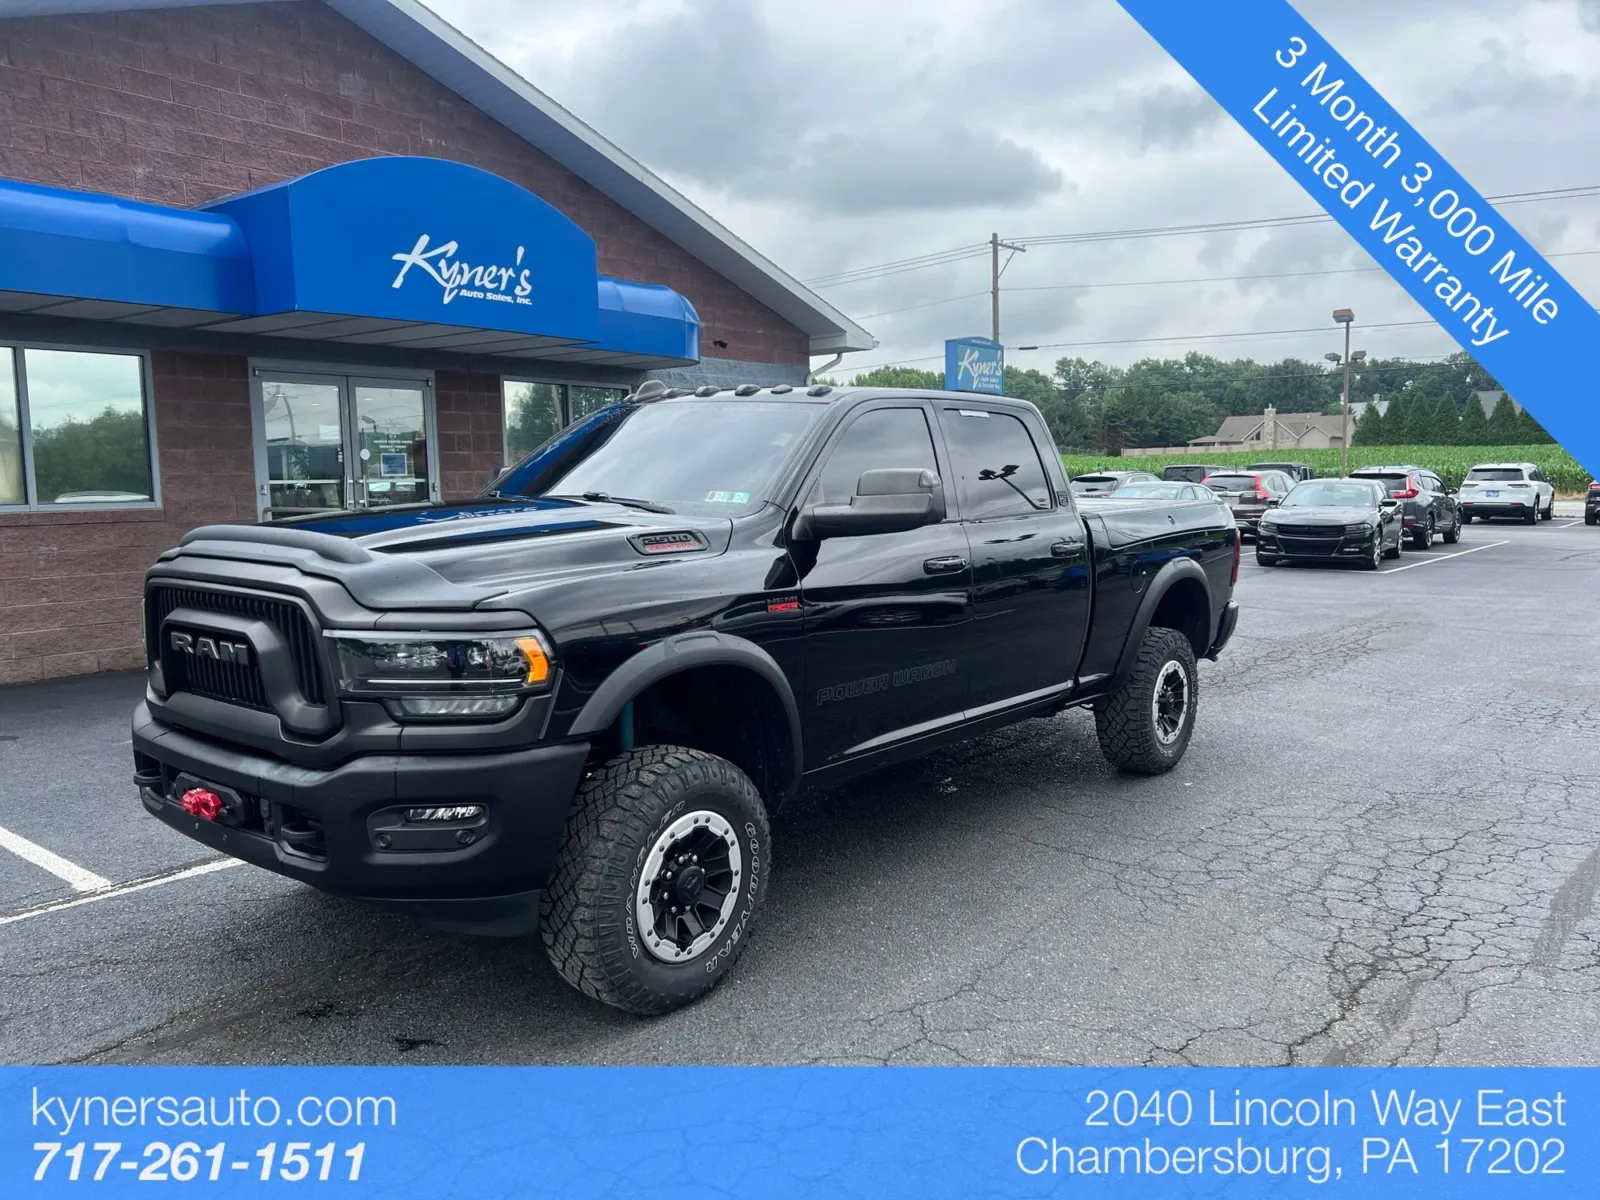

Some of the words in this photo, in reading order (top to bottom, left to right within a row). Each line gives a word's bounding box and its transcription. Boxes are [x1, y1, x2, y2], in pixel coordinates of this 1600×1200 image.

[391, 234, 532, 305] Kyner's
[459, 289, 484, 299] Auto
[485, 292, 514, 304] Sales,
[516, 296, 533, 306] Inc.
[958, 348, 1002, 390] Kyner's
[170, 632, 248, 665] RAM
[816, 674, 889, 706] POWER
[893, 658, 957, 687] WAGON
[626, 801, 685, 958] WRANGLER
[706, 822, 760, 972] GOODYEAR
